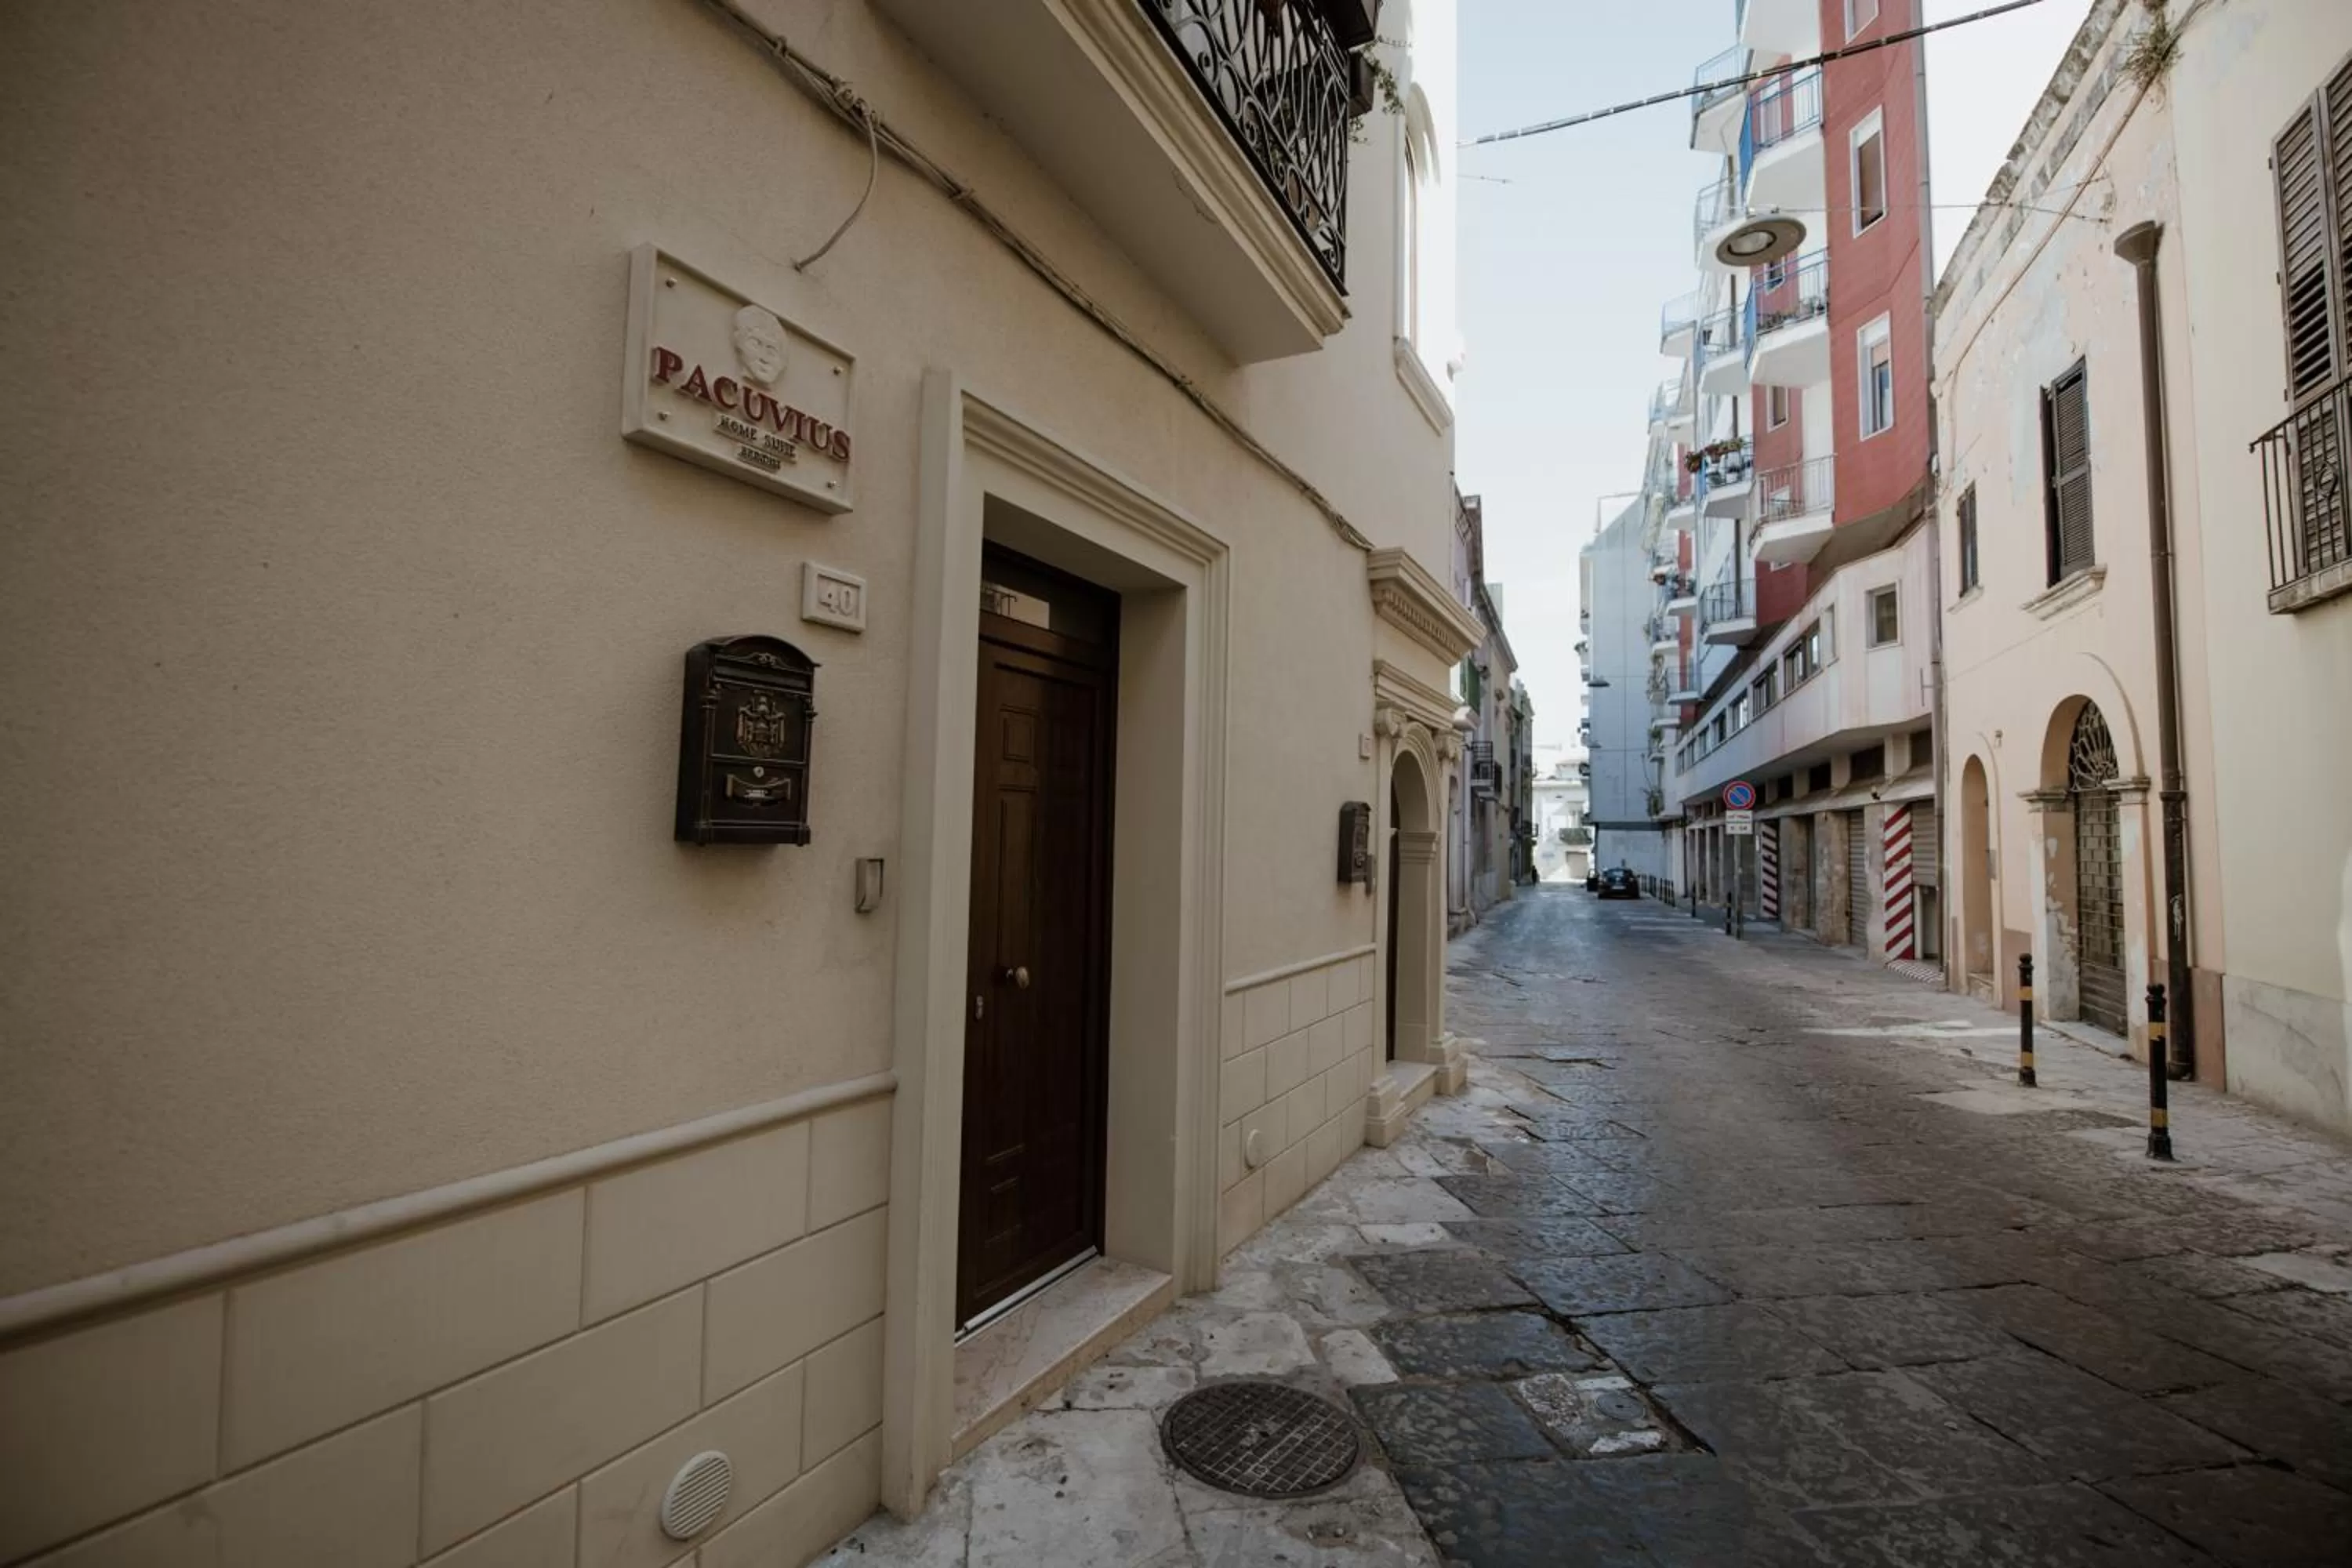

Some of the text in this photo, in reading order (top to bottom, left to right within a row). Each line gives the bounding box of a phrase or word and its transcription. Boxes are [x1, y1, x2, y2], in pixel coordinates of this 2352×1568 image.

[653, 347, 851, 459] PACUVIUS
[717, 415, 757, 440] HOME
[818, 582, 854, 616] 40
